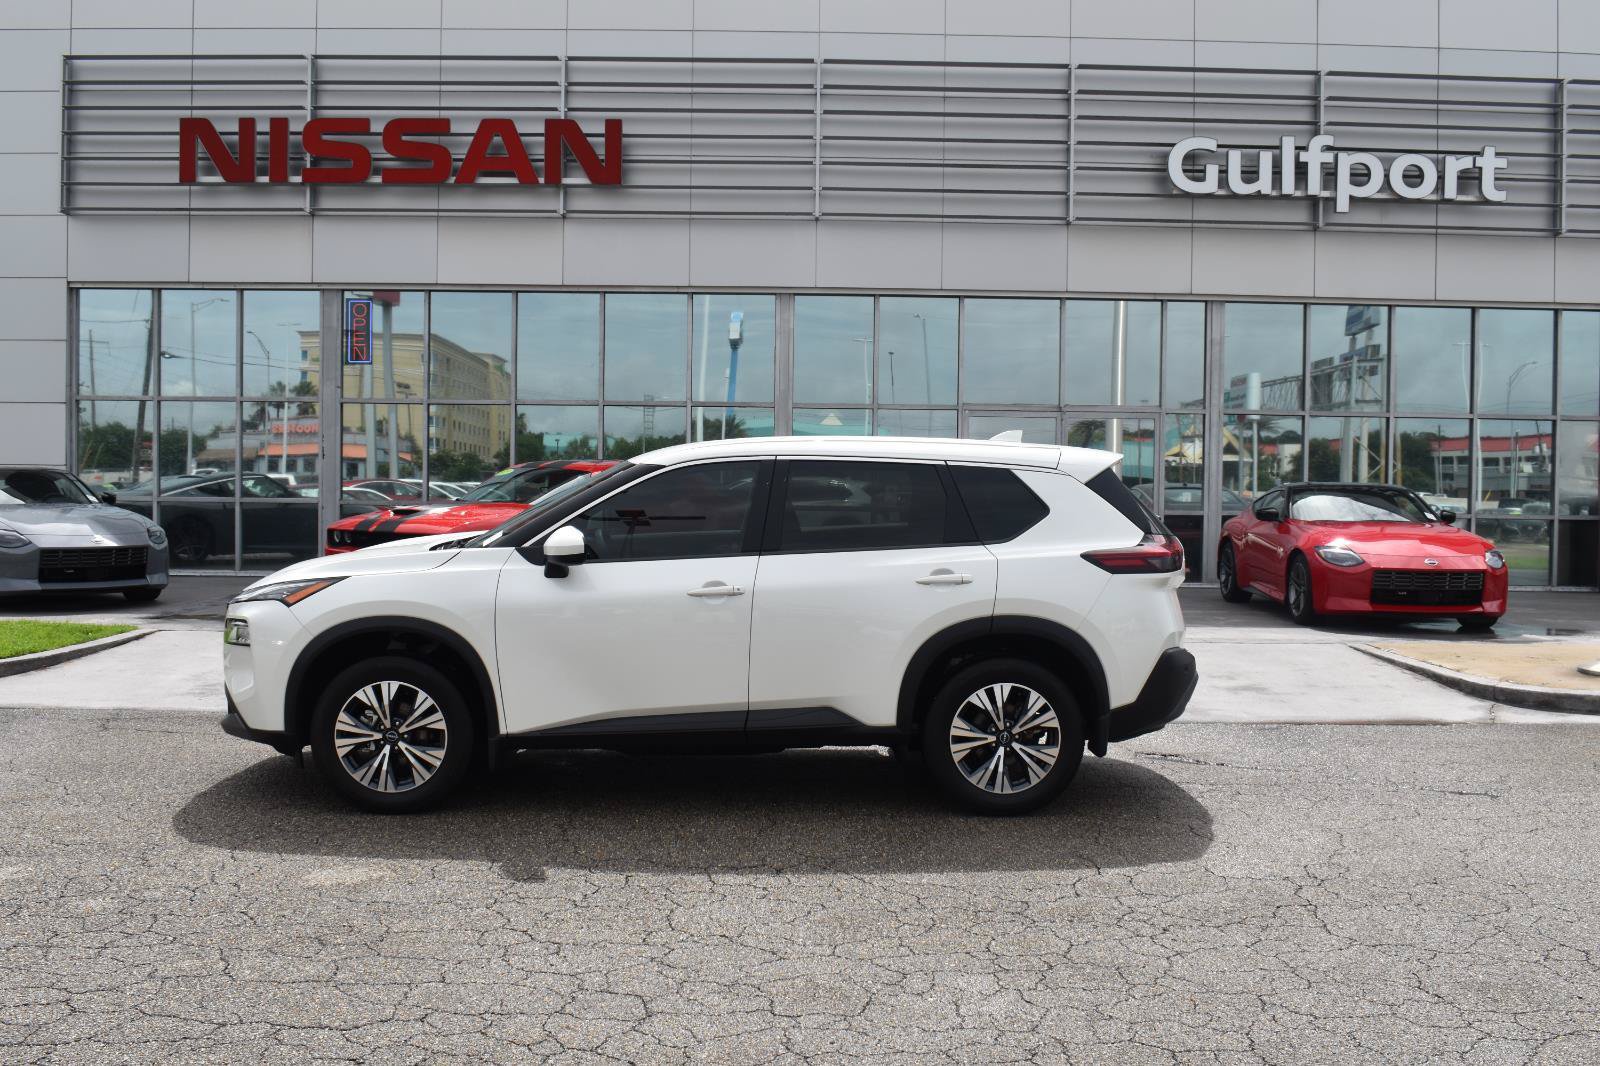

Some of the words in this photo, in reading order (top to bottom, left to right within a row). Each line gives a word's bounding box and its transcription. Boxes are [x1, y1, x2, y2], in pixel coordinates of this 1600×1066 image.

[179, 117, 623, 185] NISSAN
[1167, 134, 1508, 213] Gulfport
[352, 303, 368, 361] OPEN
